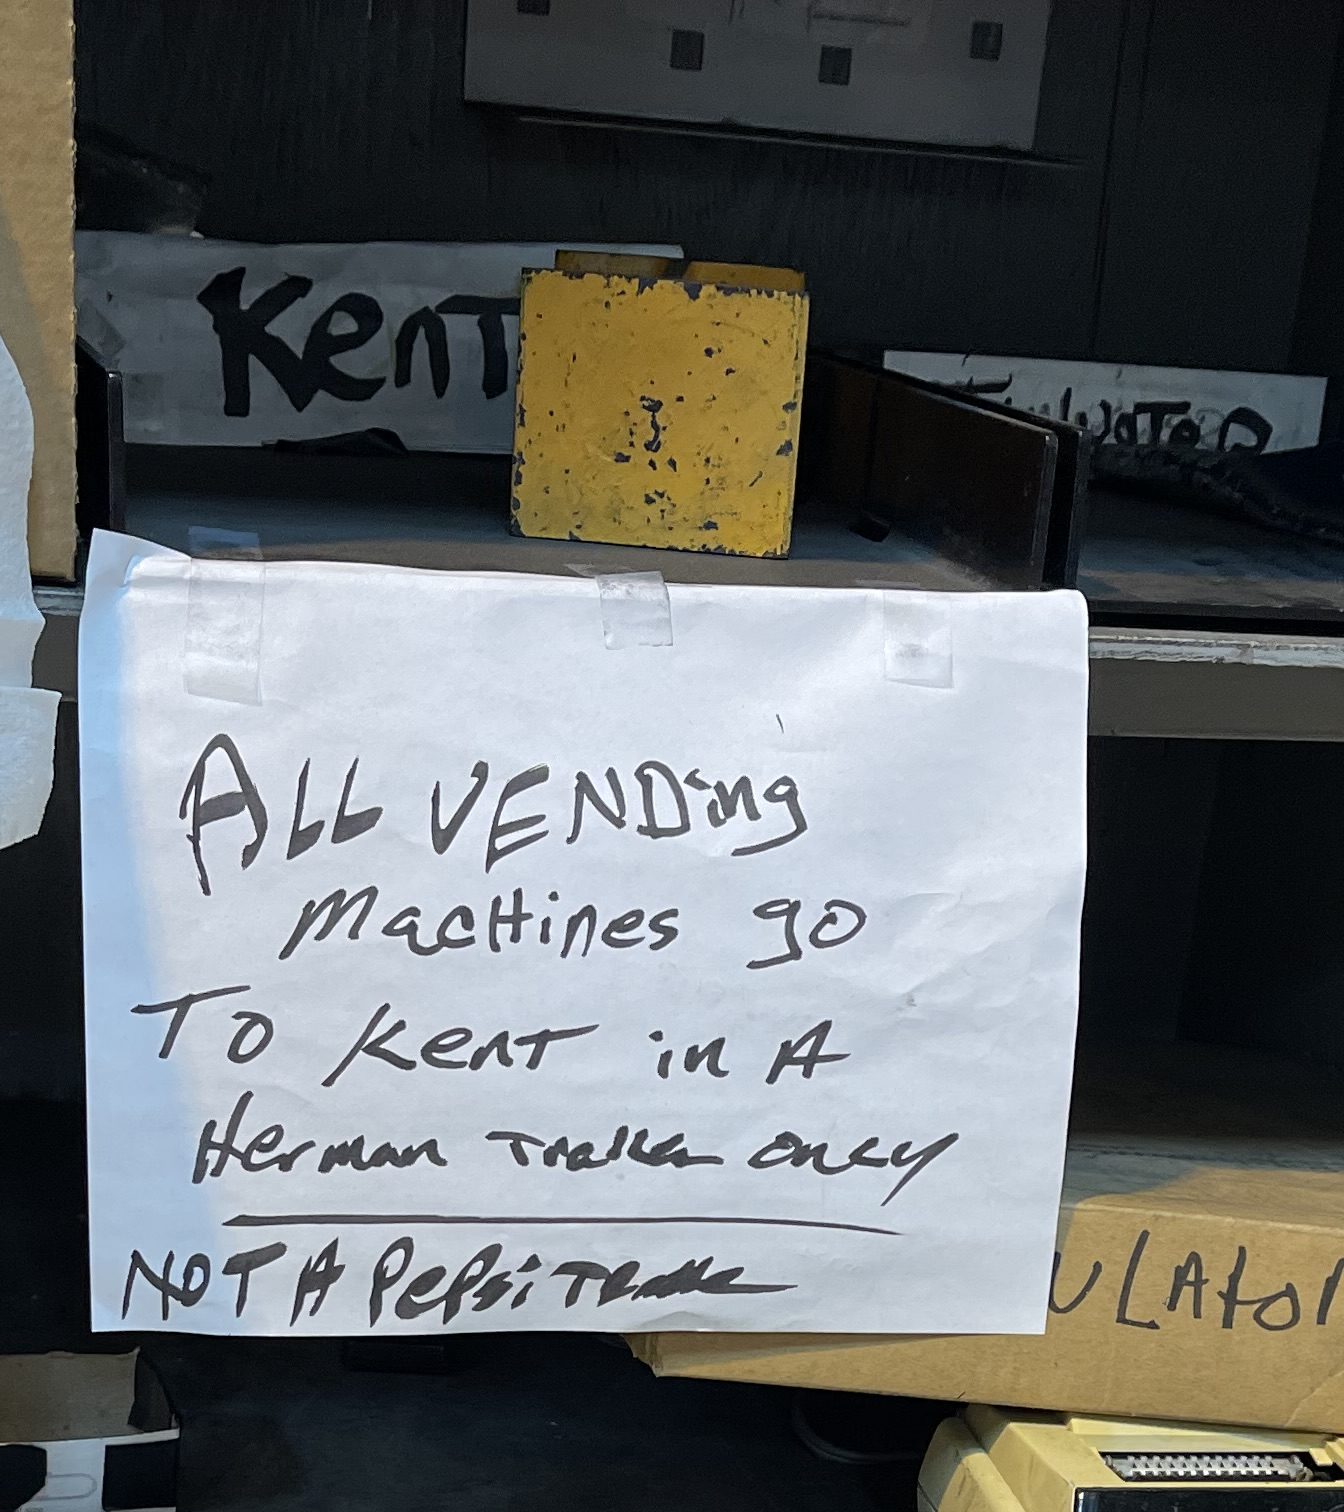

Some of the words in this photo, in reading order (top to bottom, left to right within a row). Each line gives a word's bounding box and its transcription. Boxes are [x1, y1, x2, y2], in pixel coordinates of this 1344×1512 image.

[747, 897, 867, 969] go
[653, 1027, 729, 1082] in
[766, 1018, 852, 1085] A
[291, 1236, 346, 1328] A
